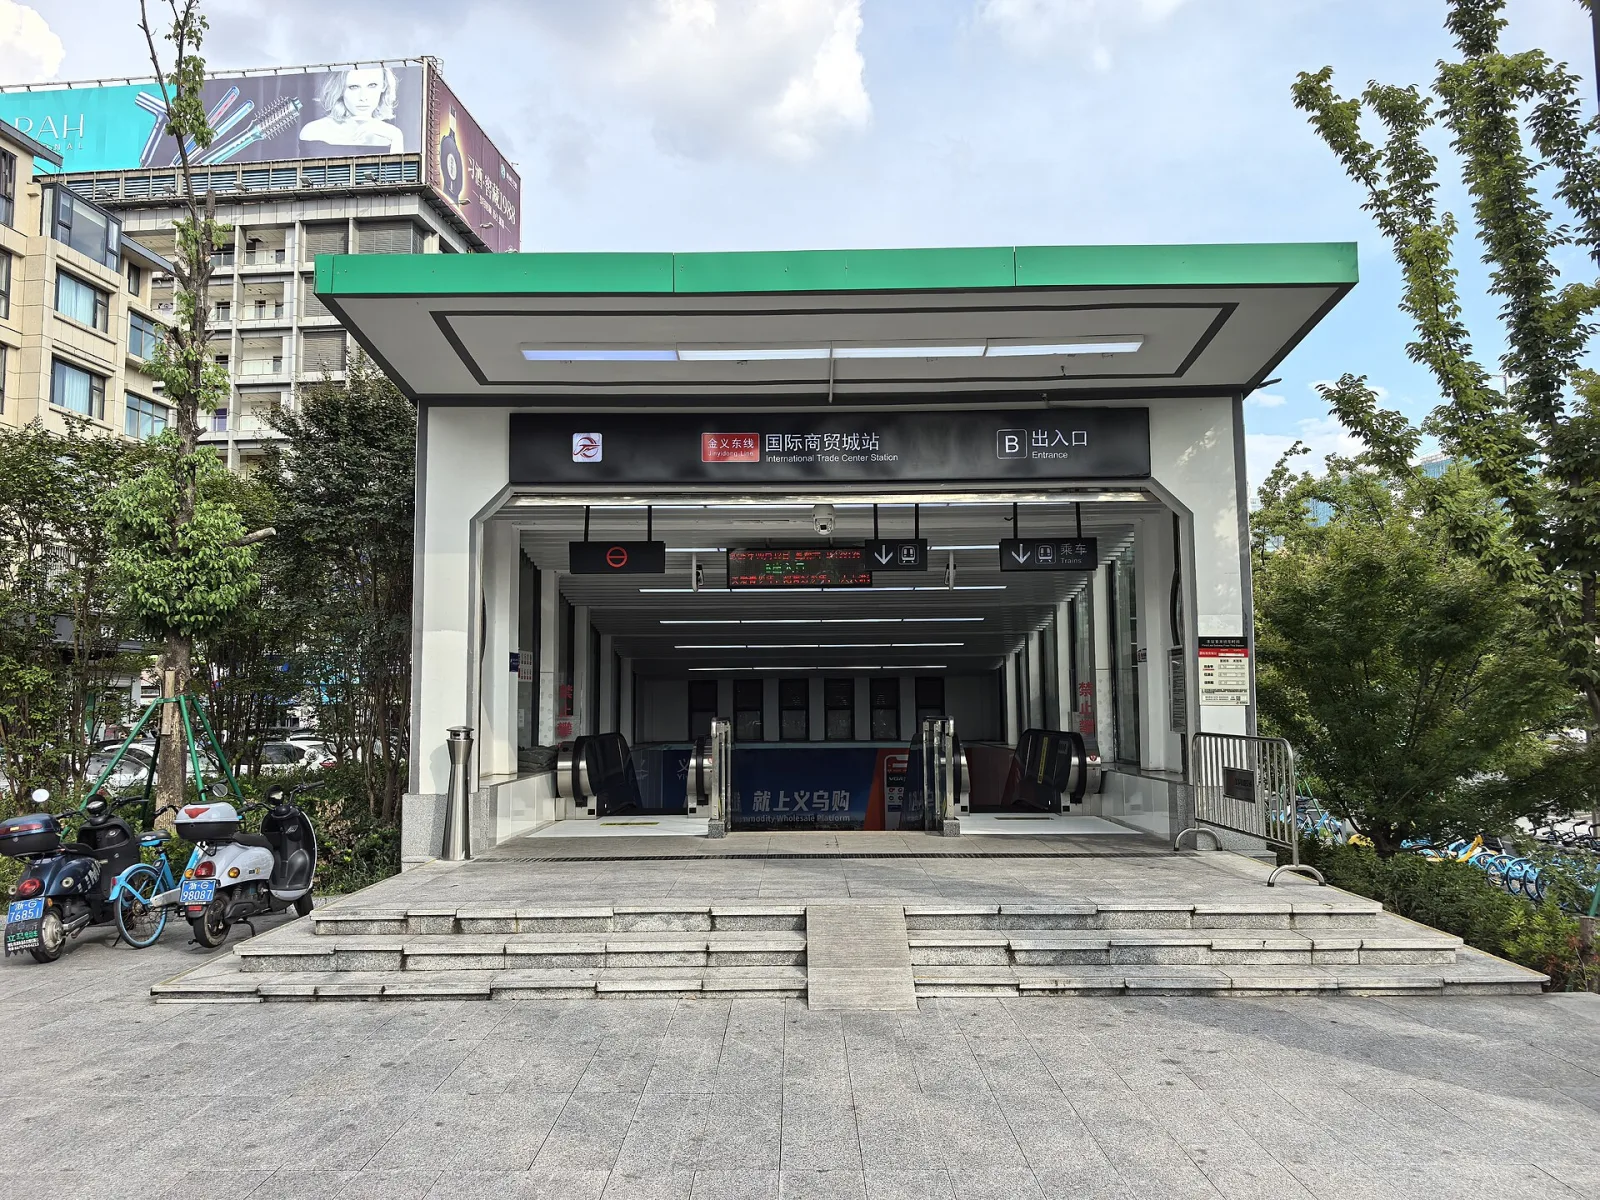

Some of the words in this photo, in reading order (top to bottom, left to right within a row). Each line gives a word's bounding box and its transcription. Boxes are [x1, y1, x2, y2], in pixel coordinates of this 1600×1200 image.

[707, 437, 755, 449] 金义东线
[765, 433, 880, 452] 国际商贸城站
[1004, 435, 1020, 453] B
[1031, 429, 1088, 448] 出入口
[765, 454, 815, 463] International
[816, 454, 840, 462] Trade
[841, 454, 869, 462] Center
[870, 453, 899, 461] Station
[1031, 450, 1068, 459] Entrance
[1060, 543, 1088, 556] 乘车
[752, 790, 850, 812] 就上义乌购
[776, 814, 815, 822] Wholesale
[816, 814, 851, 822] Platform
[183, 889, 213, 901] 98087
[10, 907, 39, 922] 76851
